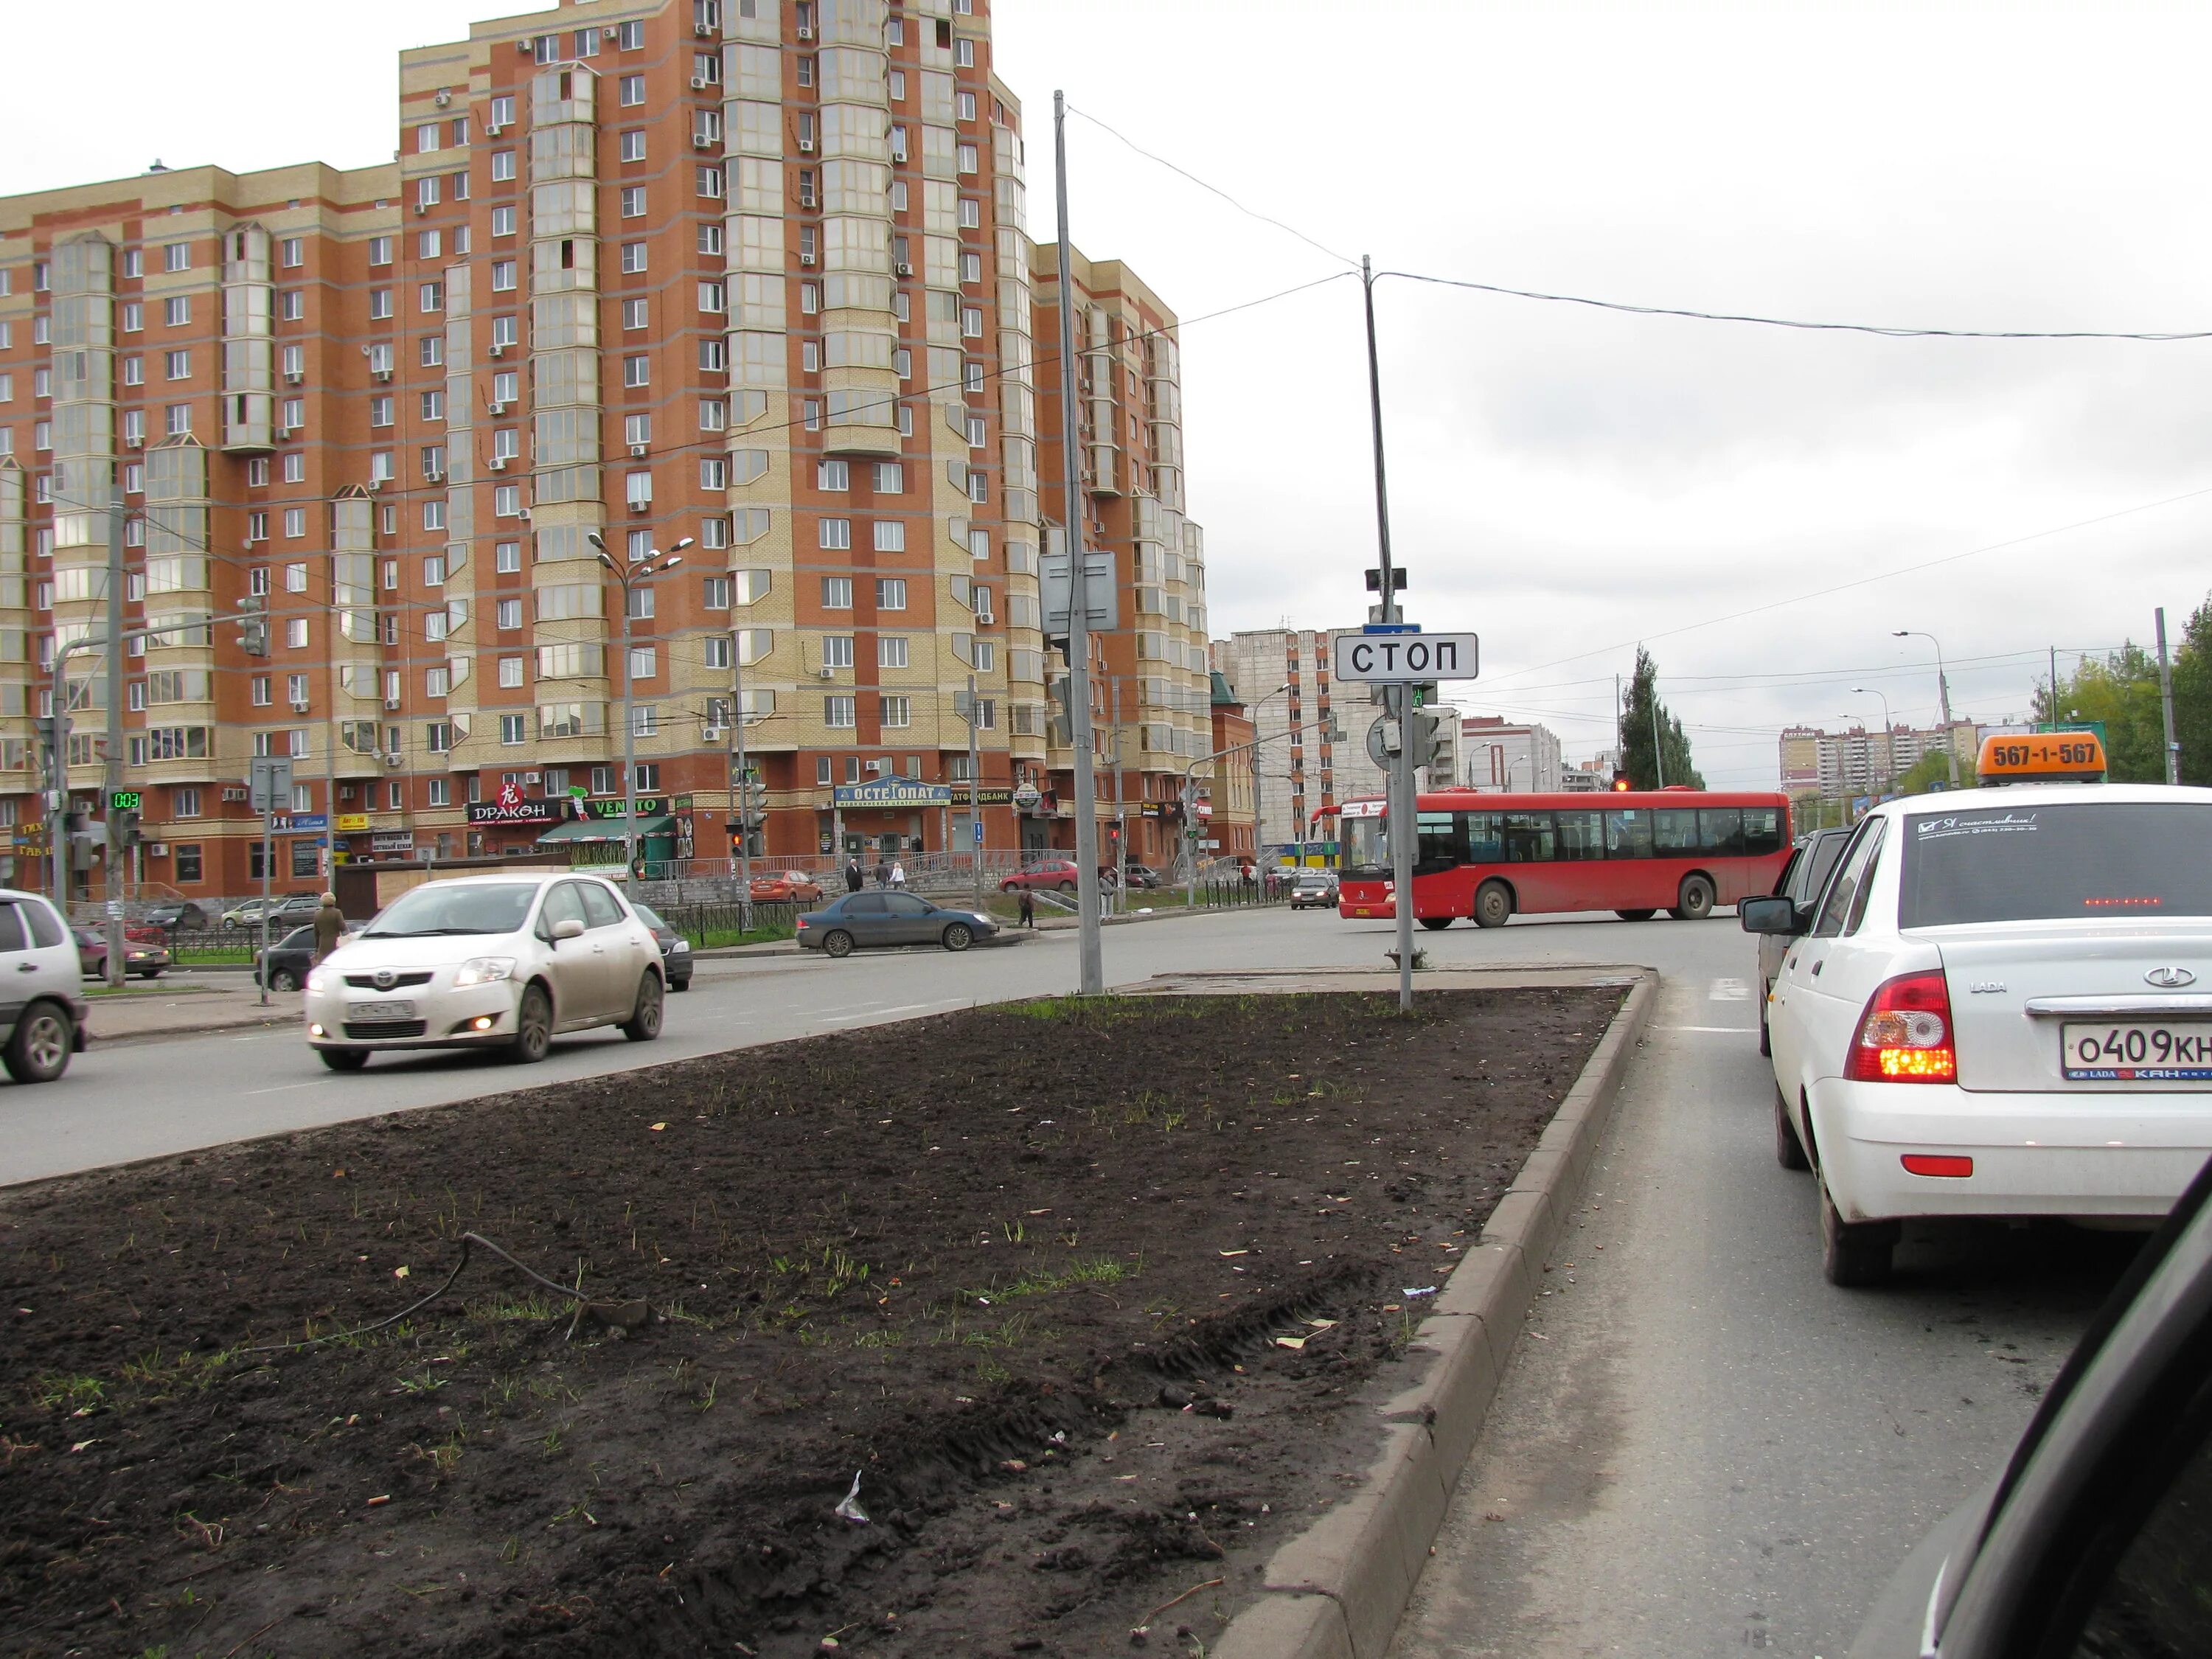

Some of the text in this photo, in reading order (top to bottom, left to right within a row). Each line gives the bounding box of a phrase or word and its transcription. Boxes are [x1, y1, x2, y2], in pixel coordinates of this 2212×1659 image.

[1352, 642, 1457, 672] СТОП
[1994, 743, 2096, 766] 567-1-567
[501, 784, 519, 805] 龙
[854, 787, 935, 800] ОСТЕОПАТ
[950, 793, 1009, 801] АТФНДБАНК
[475, 805, 546, 819] ДРАКОН
[595, 799, 657, 813] VENTO
[1969, 981, 2007, 993] LADA
